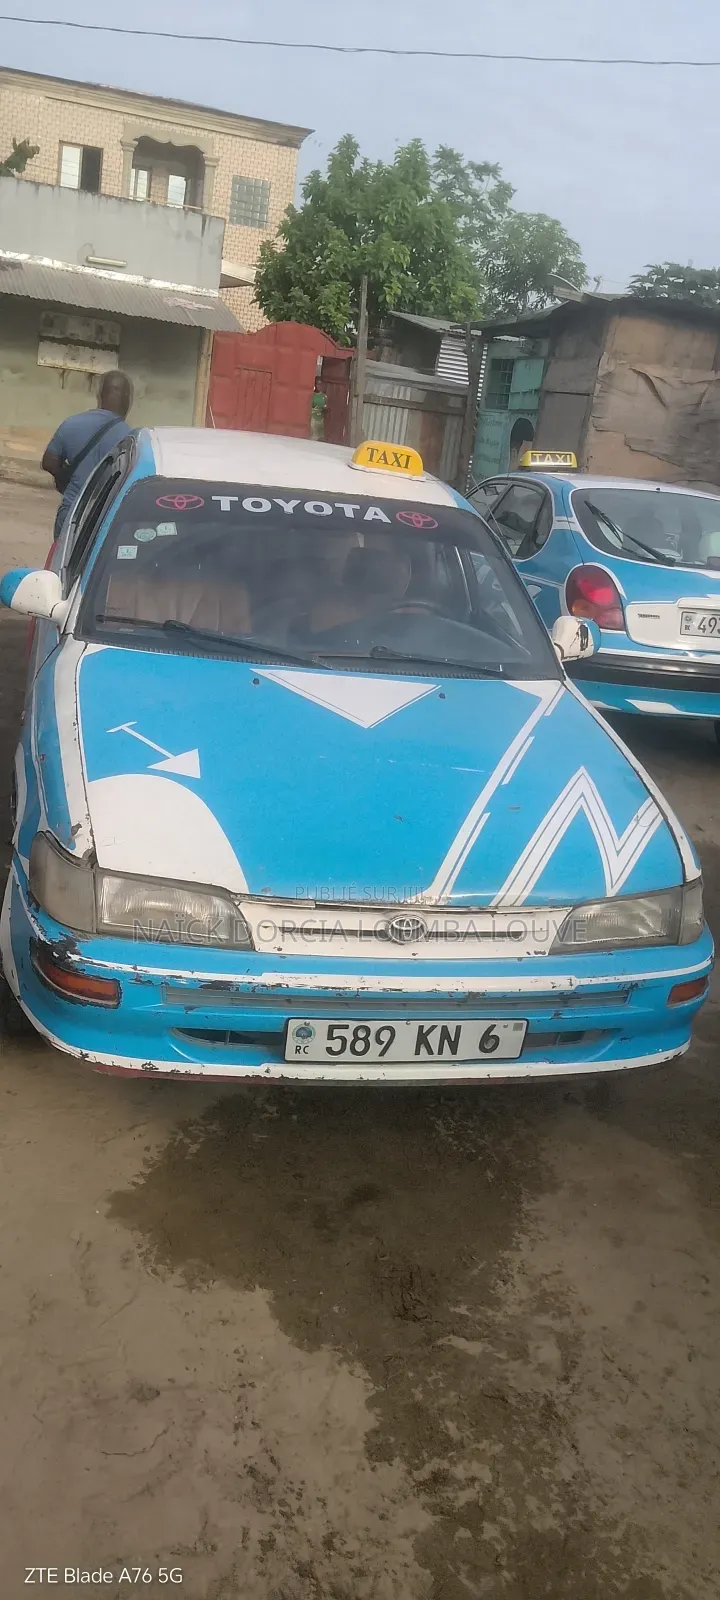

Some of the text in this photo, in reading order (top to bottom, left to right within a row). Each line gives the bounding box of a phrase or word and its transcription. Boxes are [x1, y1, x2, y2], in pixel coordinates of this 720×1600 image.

[366, 446, 412, 469] TAXI
[532, 453, 571, 463] TAXI
[211, 495, 392, 524] TOYOTA
[294, 1044, 310, 1055] RC
[325, 1023, 500, 1057] 589 KN 6
